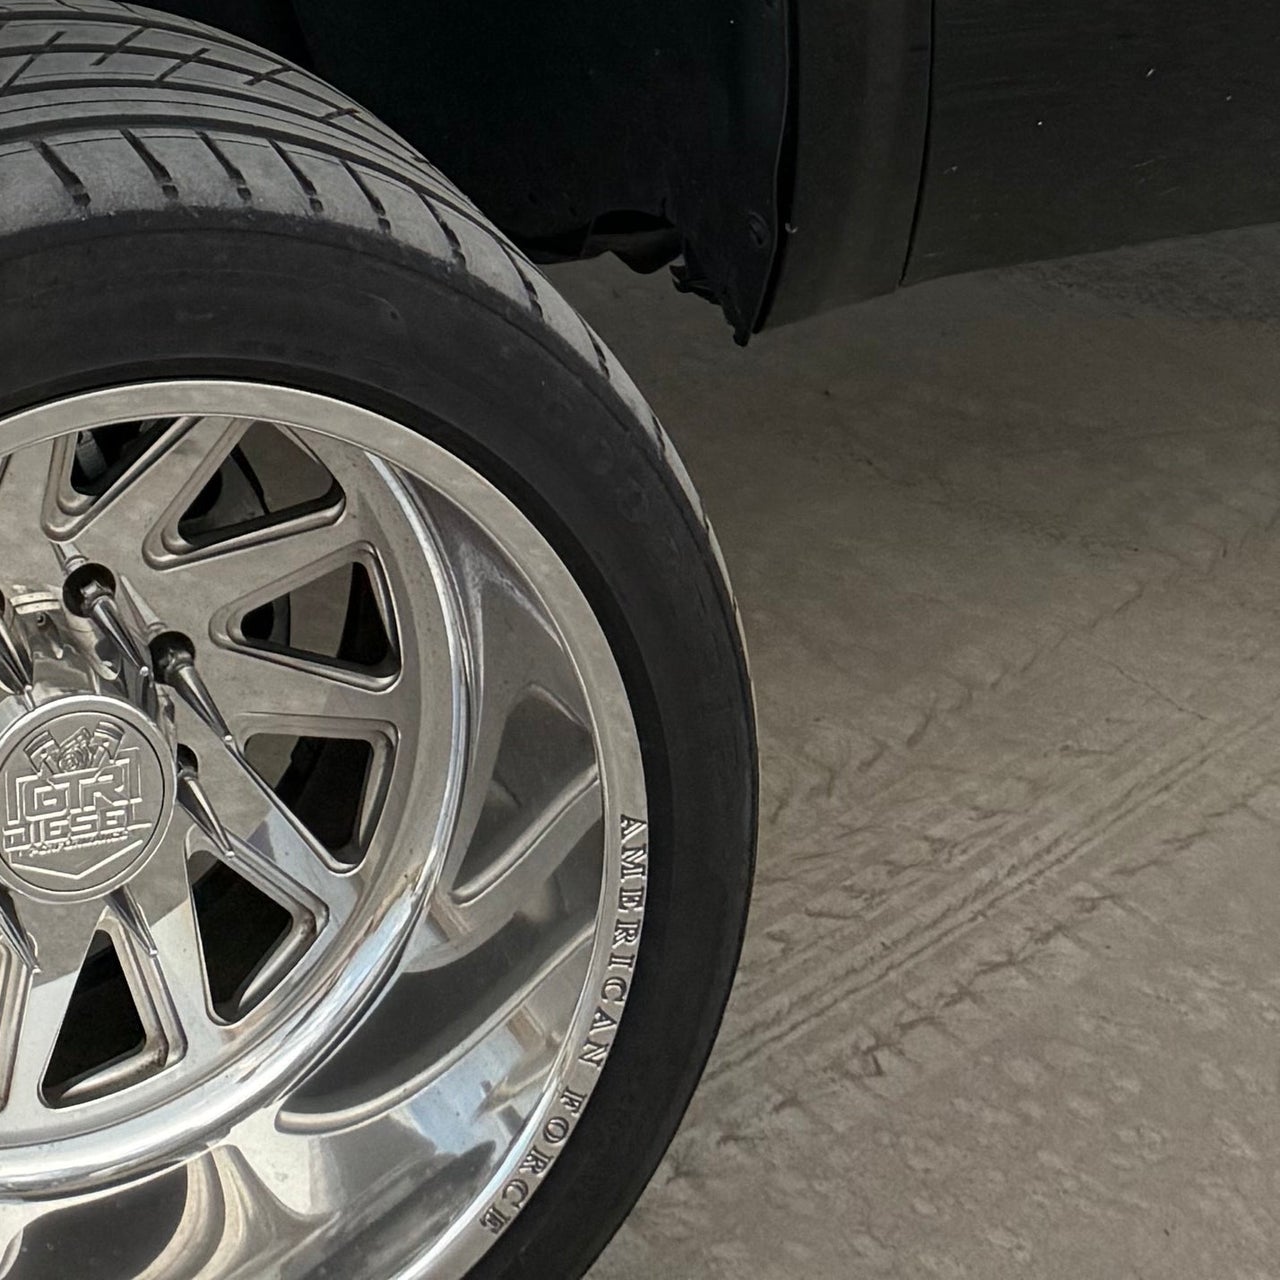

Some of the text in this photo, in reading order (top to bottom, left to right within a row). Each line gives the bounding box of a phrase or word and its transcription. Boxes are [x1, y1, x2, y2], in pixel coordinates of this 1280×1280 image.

[23, 759, 130, 822] GTR
[2, 805, 153, 853] DIESEL
[479, 813, 649, 1235] AMERICAN FORCE
